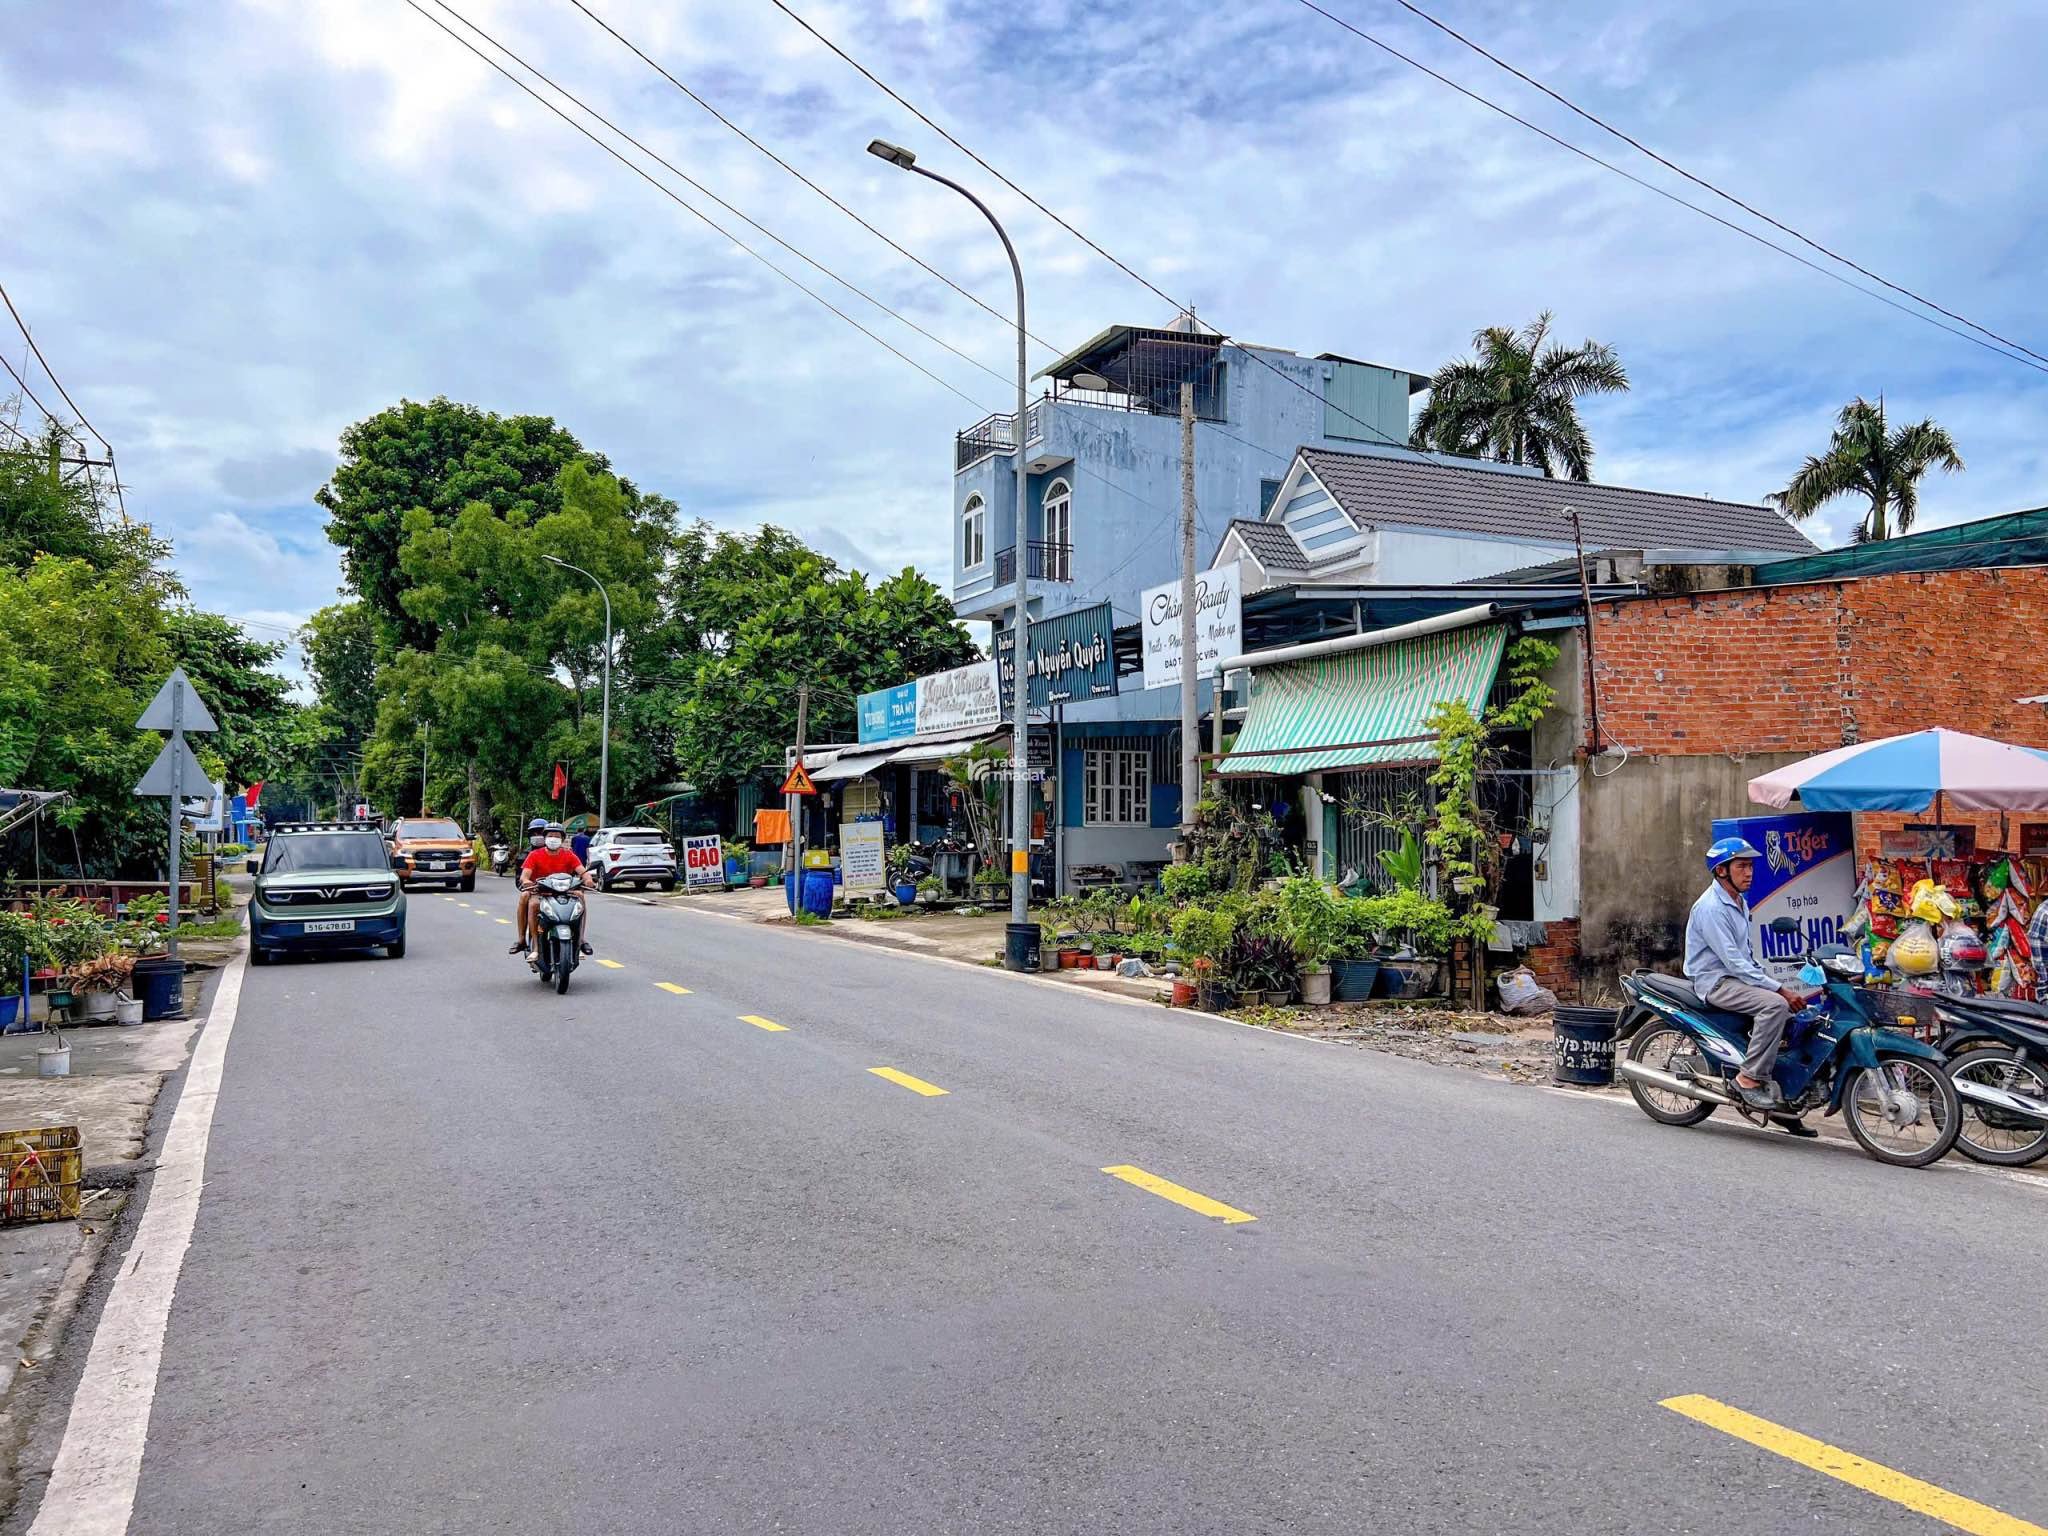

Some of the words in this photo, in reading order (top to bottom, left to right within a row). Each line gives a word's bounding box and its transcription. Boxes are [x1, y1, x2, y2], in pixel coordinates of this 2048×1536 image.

[1196, 580, 1230, 619] Beauty
[999, 657, 1014, 681] Tóc
[1037, 639, 1072, 681] Nguyễn
[1074, 632, 1105, 673] Quyết
[687, 839, 704, 849] ĐẠI
[706, 837, 717, 847] LÝ
[688, 847, 719, 871] GẠO
[1784, 827, 1829, 861] Tiger
[1786, 896, 1802, 909] Tạp
[1803, 895, 1819, 907] hóa
[1760, 915, 1803, 959] NHƯ
[1807, 914, 1849, 951] HOA
